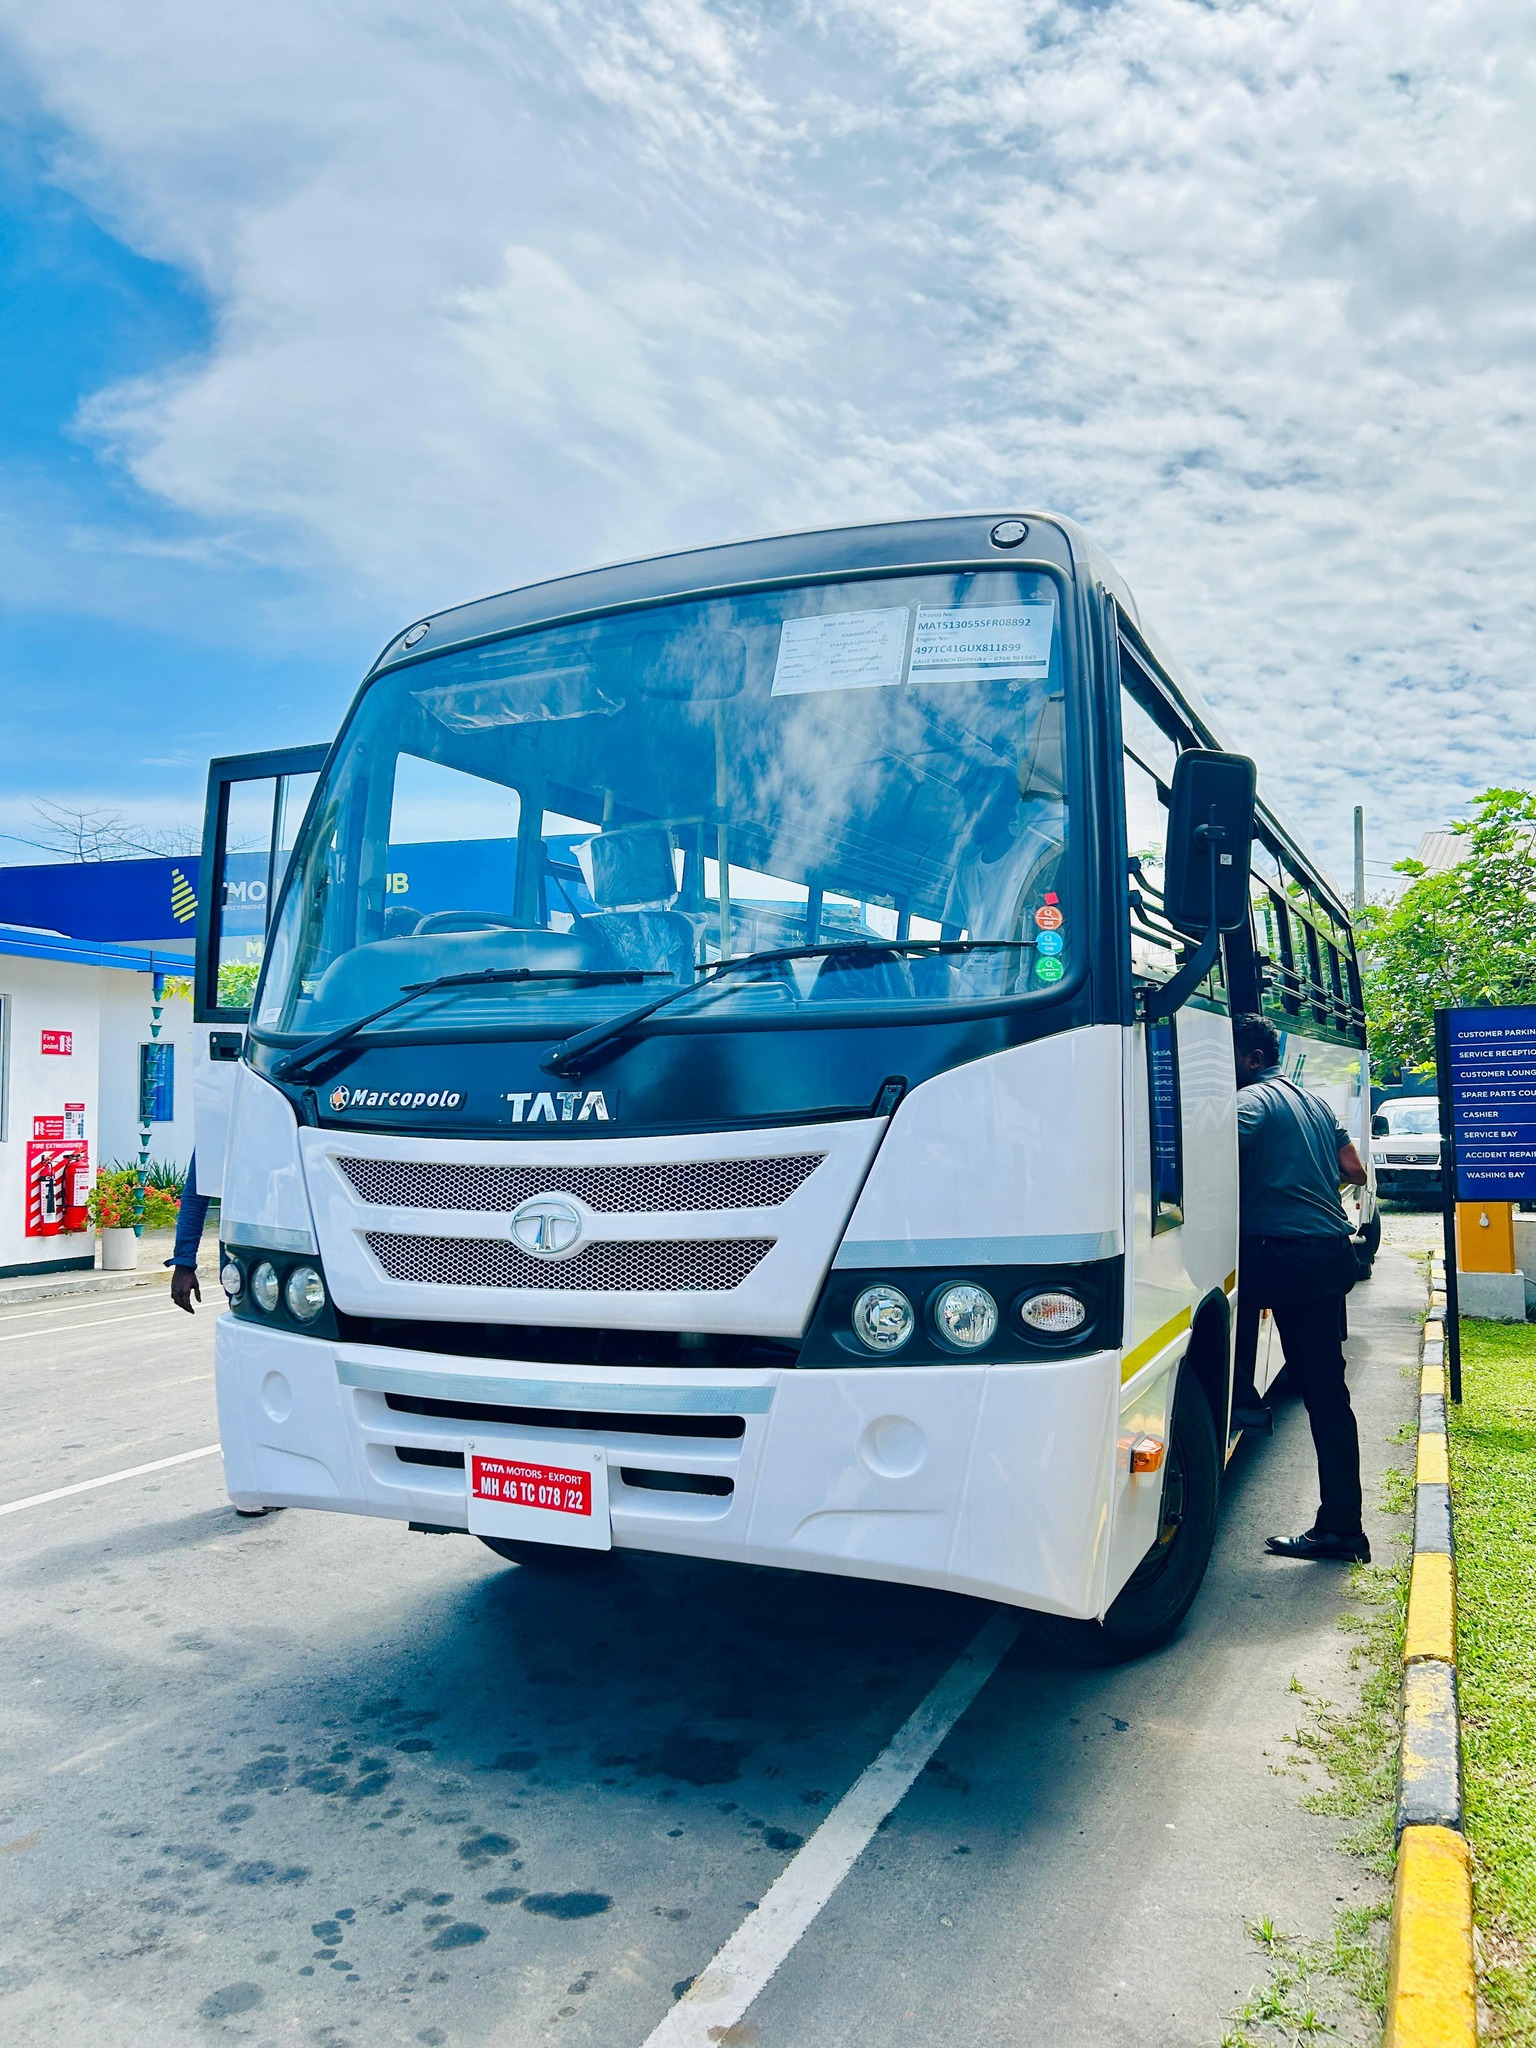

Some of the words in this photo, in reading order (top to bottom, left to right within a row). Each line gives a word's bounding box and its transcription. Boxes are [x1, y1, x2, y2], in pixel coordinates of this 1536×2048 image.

[914, 643, 1022, 655] 497TC41GUX811899
[43, 1033, 55, 1041] Fire
[1458, 1030, 1503, 1039] CUSTOMER
[43, 1043, 59, 1051] point
[1459, 1050, 1494, 1059] SERVICE
[1460, 1070, 1505, 1078] CUSTOMER
[1518, 1089, 1536, 1097] COU
[350, 1089, 461, 1108] Marcopolo
[506, 1091, 610, 1122] TATA
[1463, 1111, 1499, 1119] CASHIER
[1464, 1131, 1499, 1139] SERVICE
[1465, 1151, 1507, 1159] ACCIDENT
[1467, 1171, 1507, 1179] WASHING
[480, 1462, 505, 1474] TATA
[506, 1466, 543, 1479] MOTORS
[548, 1472, 582, 1485] EXPORT
[481, 1476, 500, 1496] MH
[502, 1480, 517, 1500] 46
[520, 1482, 536, 1502] TC
[539, 1485, 561, 1507] 078
[563, 1489, 584, 1510] /22
